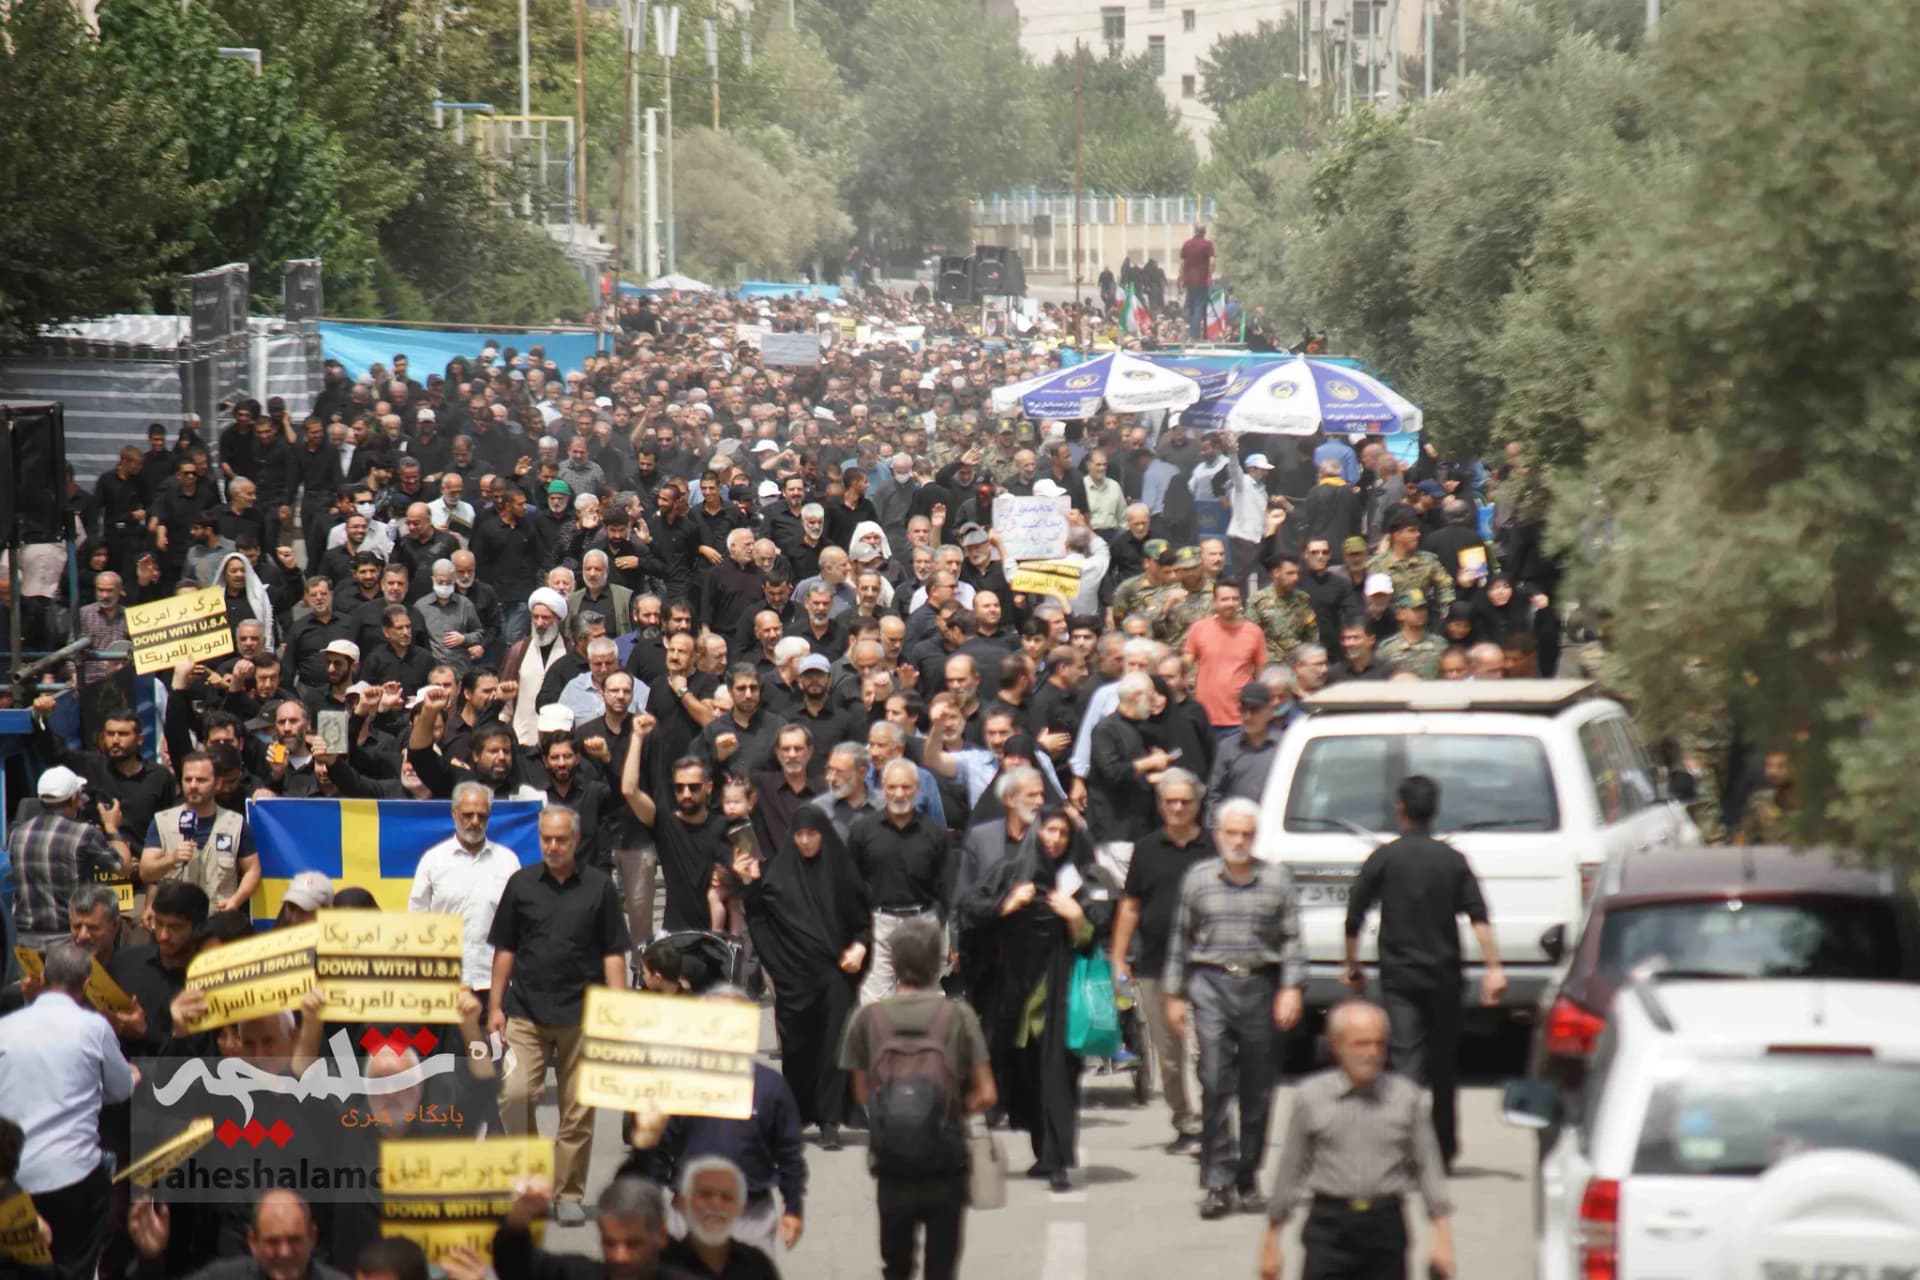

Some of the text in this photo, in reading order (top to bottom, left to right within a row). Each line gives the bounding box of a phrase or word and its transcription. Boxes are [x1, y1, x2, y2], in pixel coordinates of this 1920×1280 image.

[133, 615, 228, 646] DOWN WITH U.S.A
[390, 928, 408, 951] بر
[417, 923, 459, 951] مرگ
[186, 952, 311, 993] DOWN WITH ISRAEL
[318, 959, 369, 976] DOWN
[371, 960, 417, 977] WITH
[384, 1200, 441, 1219] DOWN
[443, 1199, 489, 1218] WITH
